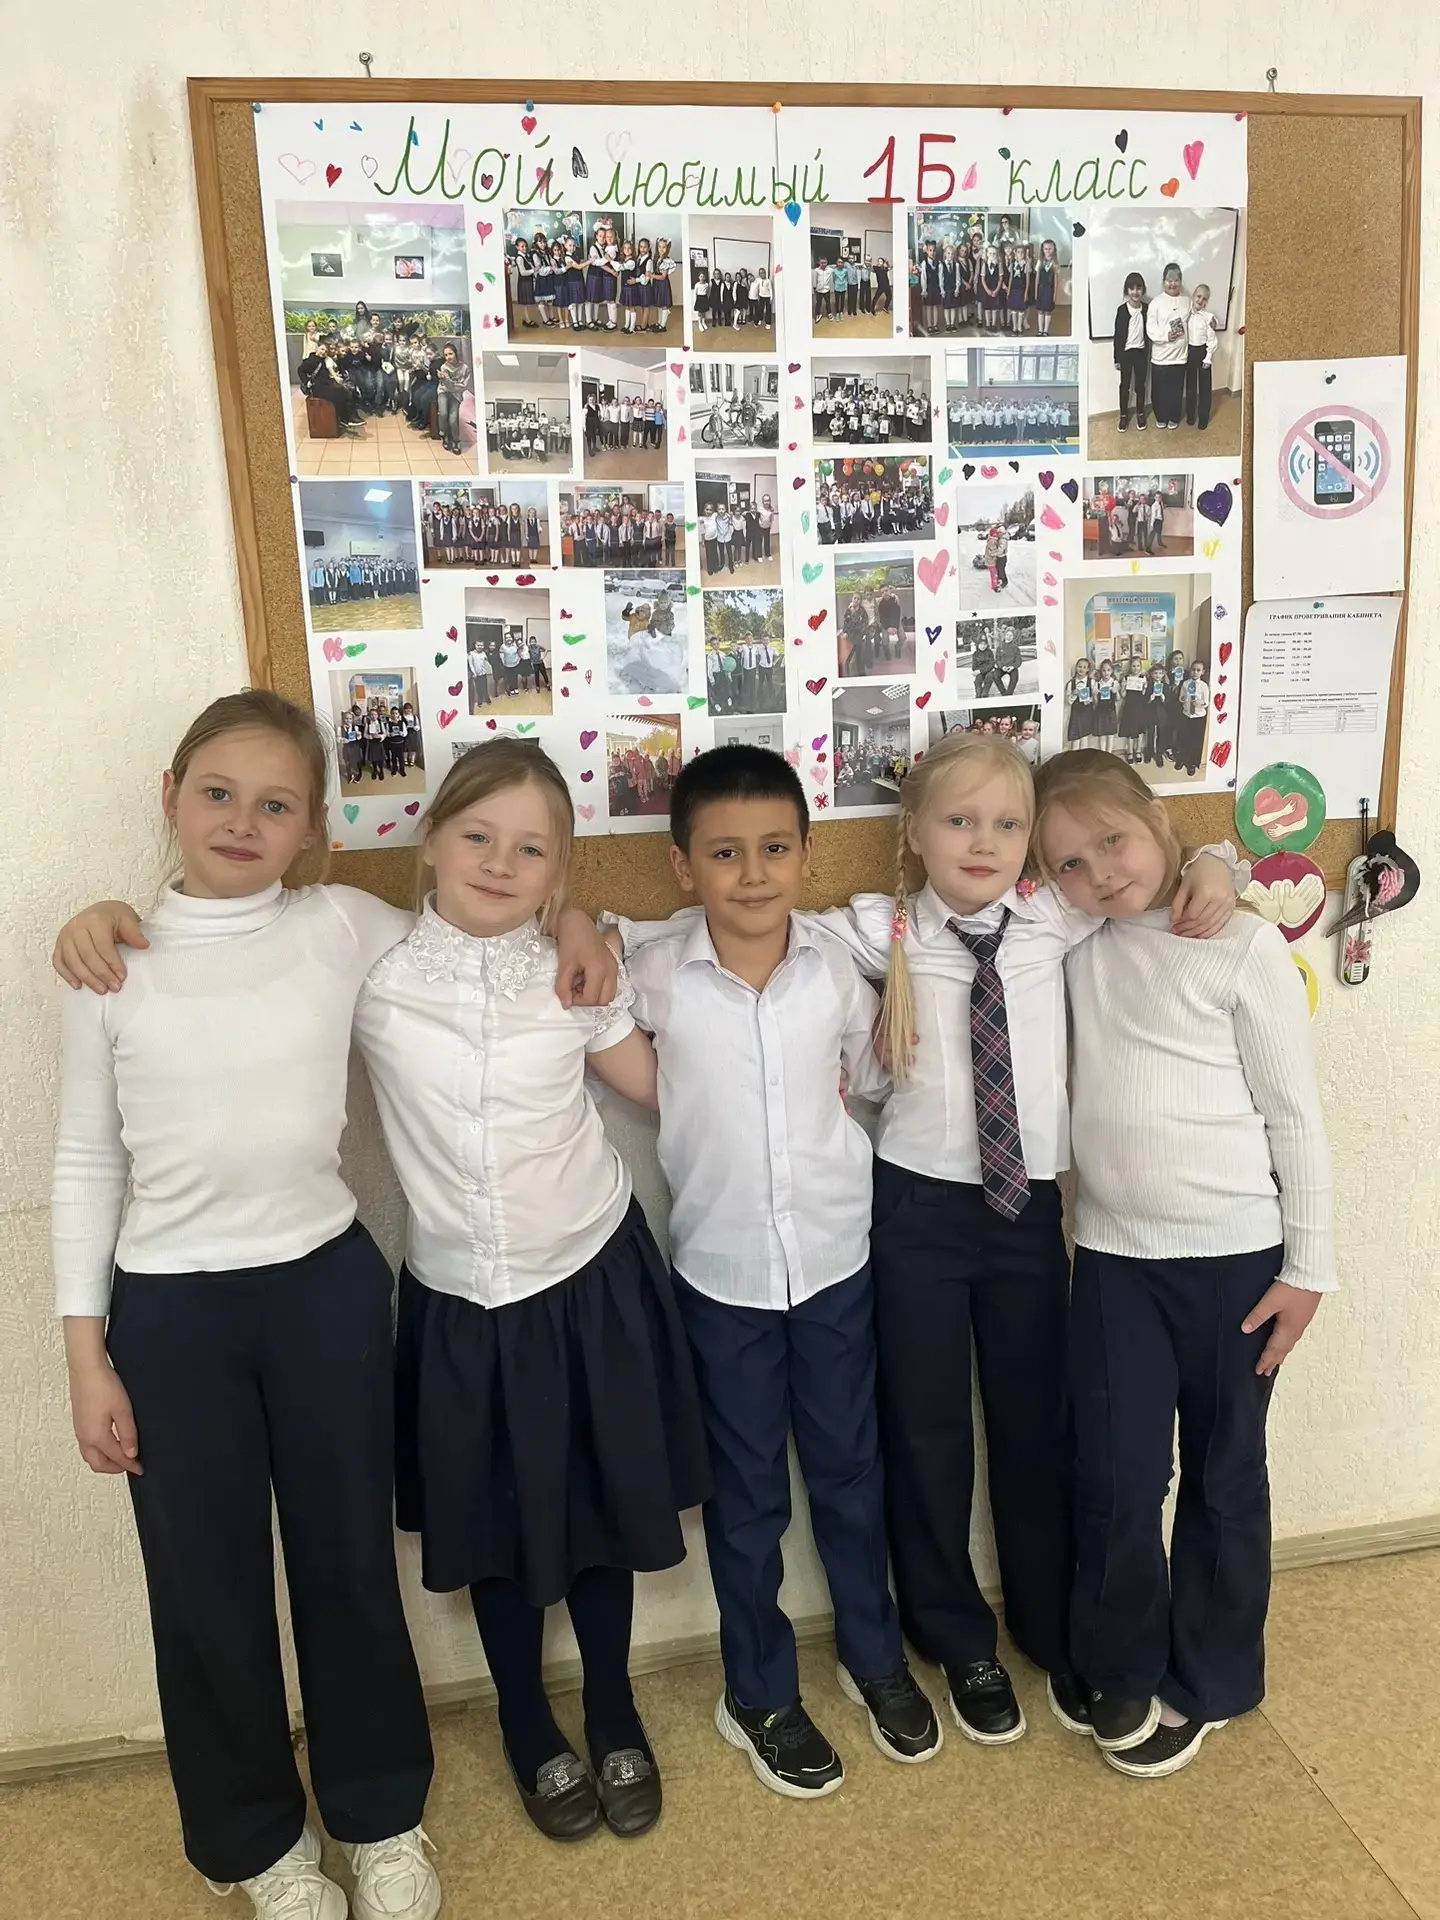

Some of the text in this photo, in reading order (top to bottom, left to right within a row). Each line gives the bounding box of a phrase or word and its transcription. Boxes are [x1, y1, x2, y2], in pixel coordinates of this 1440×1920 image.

[373, 115, 1149, 208] Мой любимый 1Б класс
